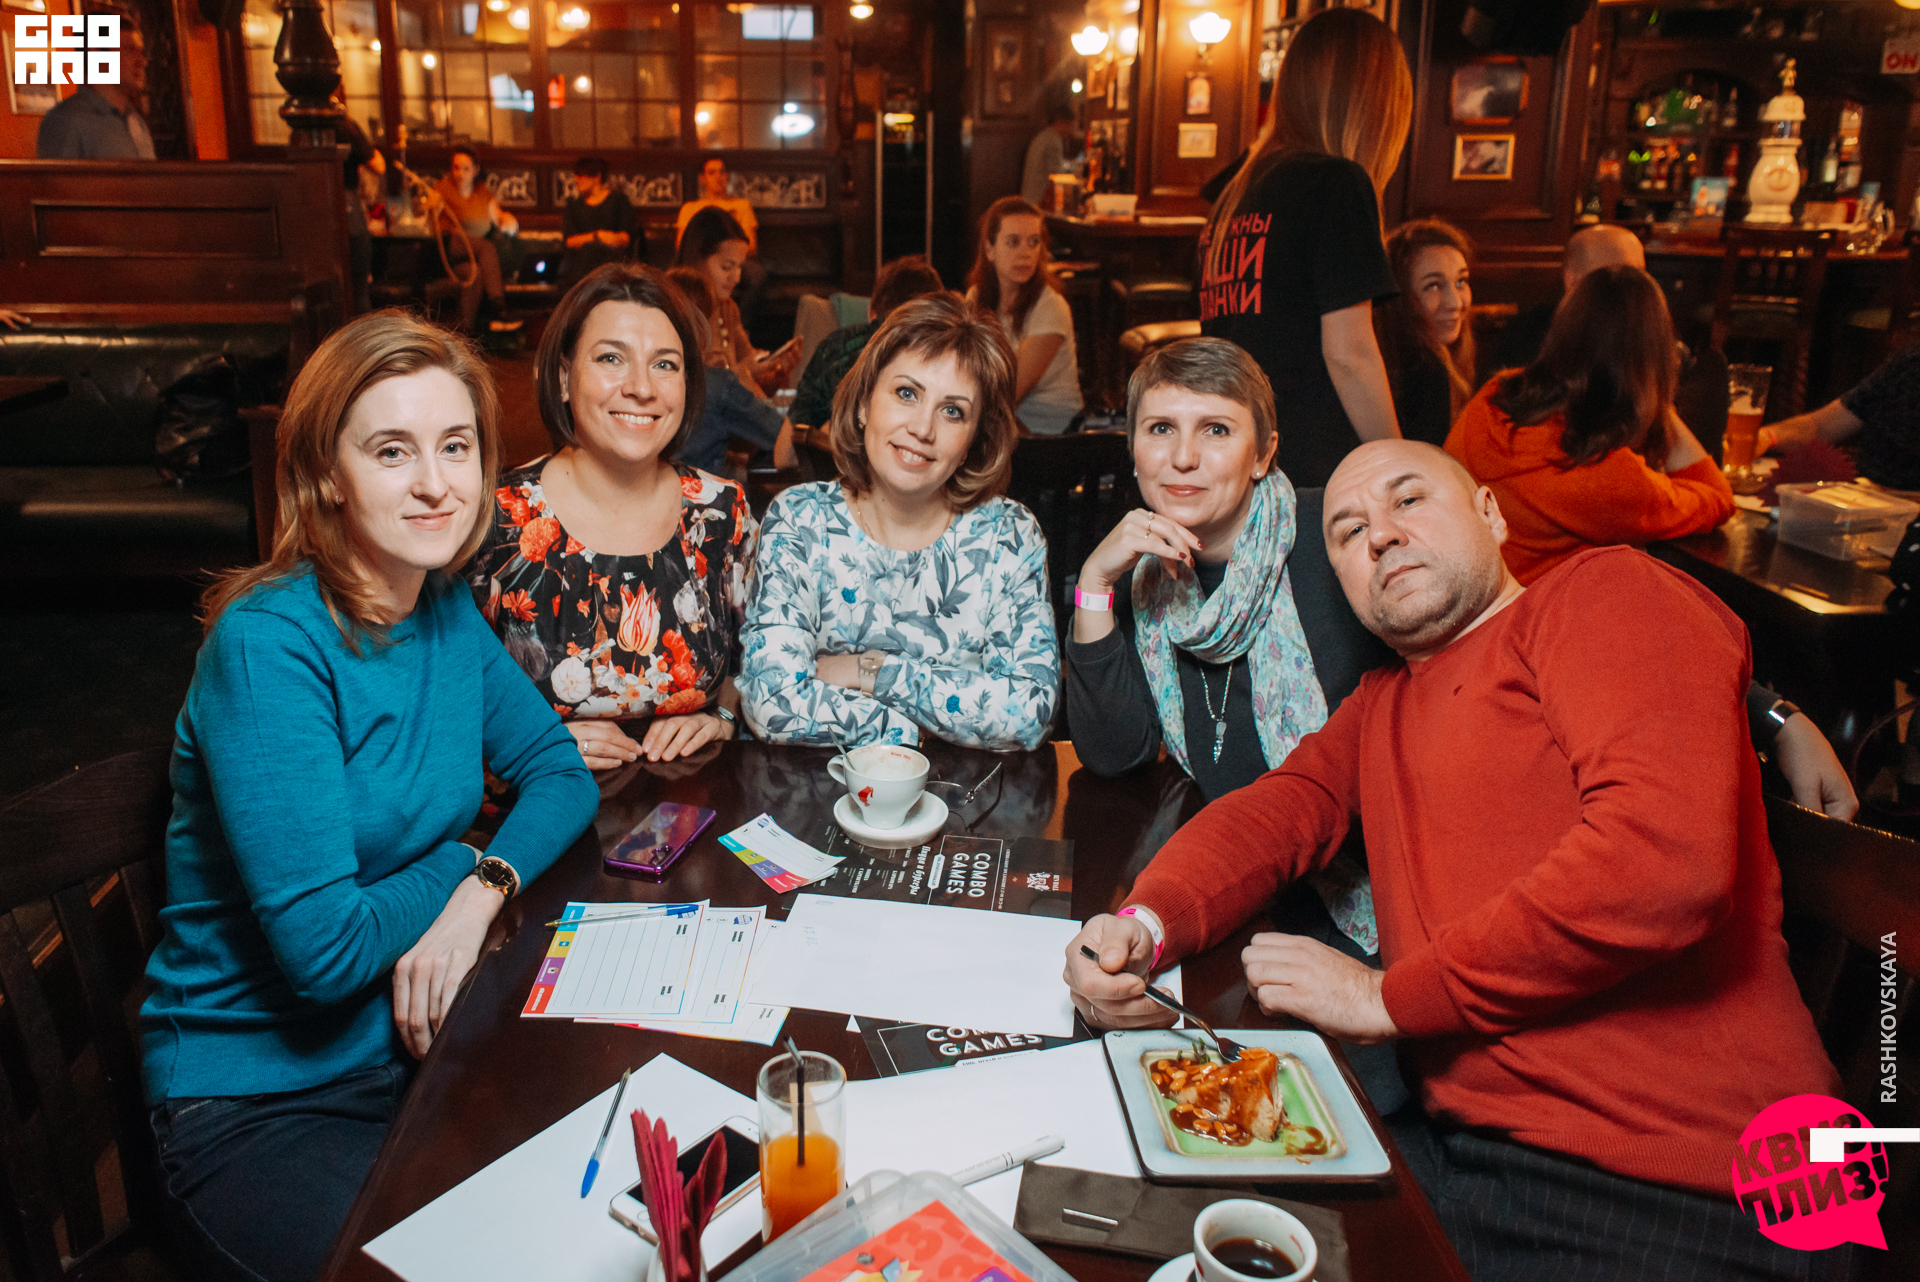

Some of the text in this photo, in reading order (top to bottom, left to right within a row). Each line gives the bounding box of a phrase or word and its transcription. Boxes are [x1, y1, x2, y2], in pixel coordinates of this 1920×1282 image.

[945, 852, 970, 895] GAMES
[967, 852, 991, 898] COMBO
[938, 1033, 1042, 1057] GAMES
